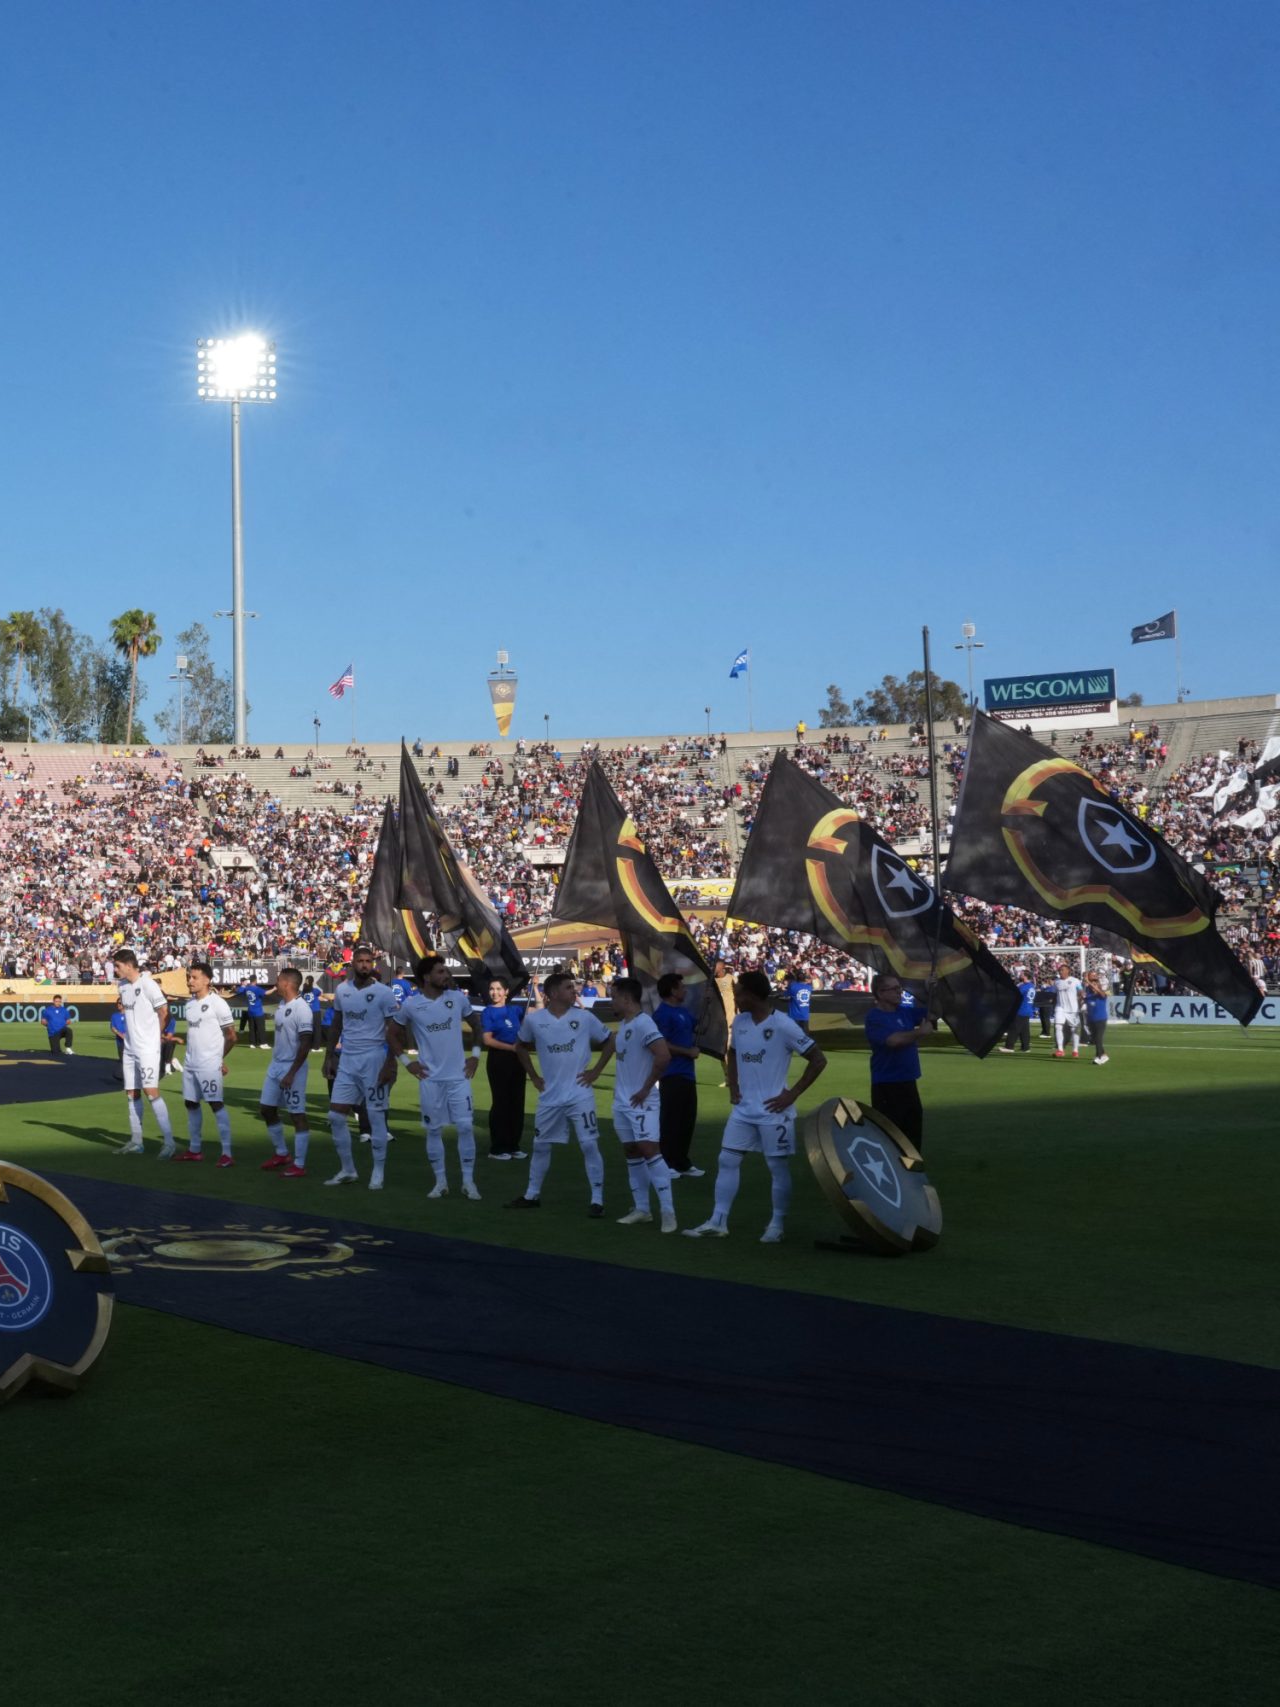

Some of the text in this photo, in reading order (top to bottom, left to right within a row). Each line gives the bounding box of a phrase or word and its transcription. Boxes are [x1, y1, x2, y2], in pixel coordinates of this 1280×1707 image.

[991, 678, 1085, 701] WESCOM
[1131, 1002, 1162, 1018] OF
[1170, 1002, 1276, 1019] AMEC
[141, 1067, 154, 1080] 32
[202, 1080, 218, 1093] 26
[368, 1087, 385, 1101] 20
[285, 1090, 300, 1105] 25
[581, 1111, 597, 1129] 10
[635, 1115, 646, 1132] 7
[776, 1124, 787, 1144] 2
[287, 1265, 376, 1280] FIFA
[11, 1295, 40, 1319] GERMAIN
